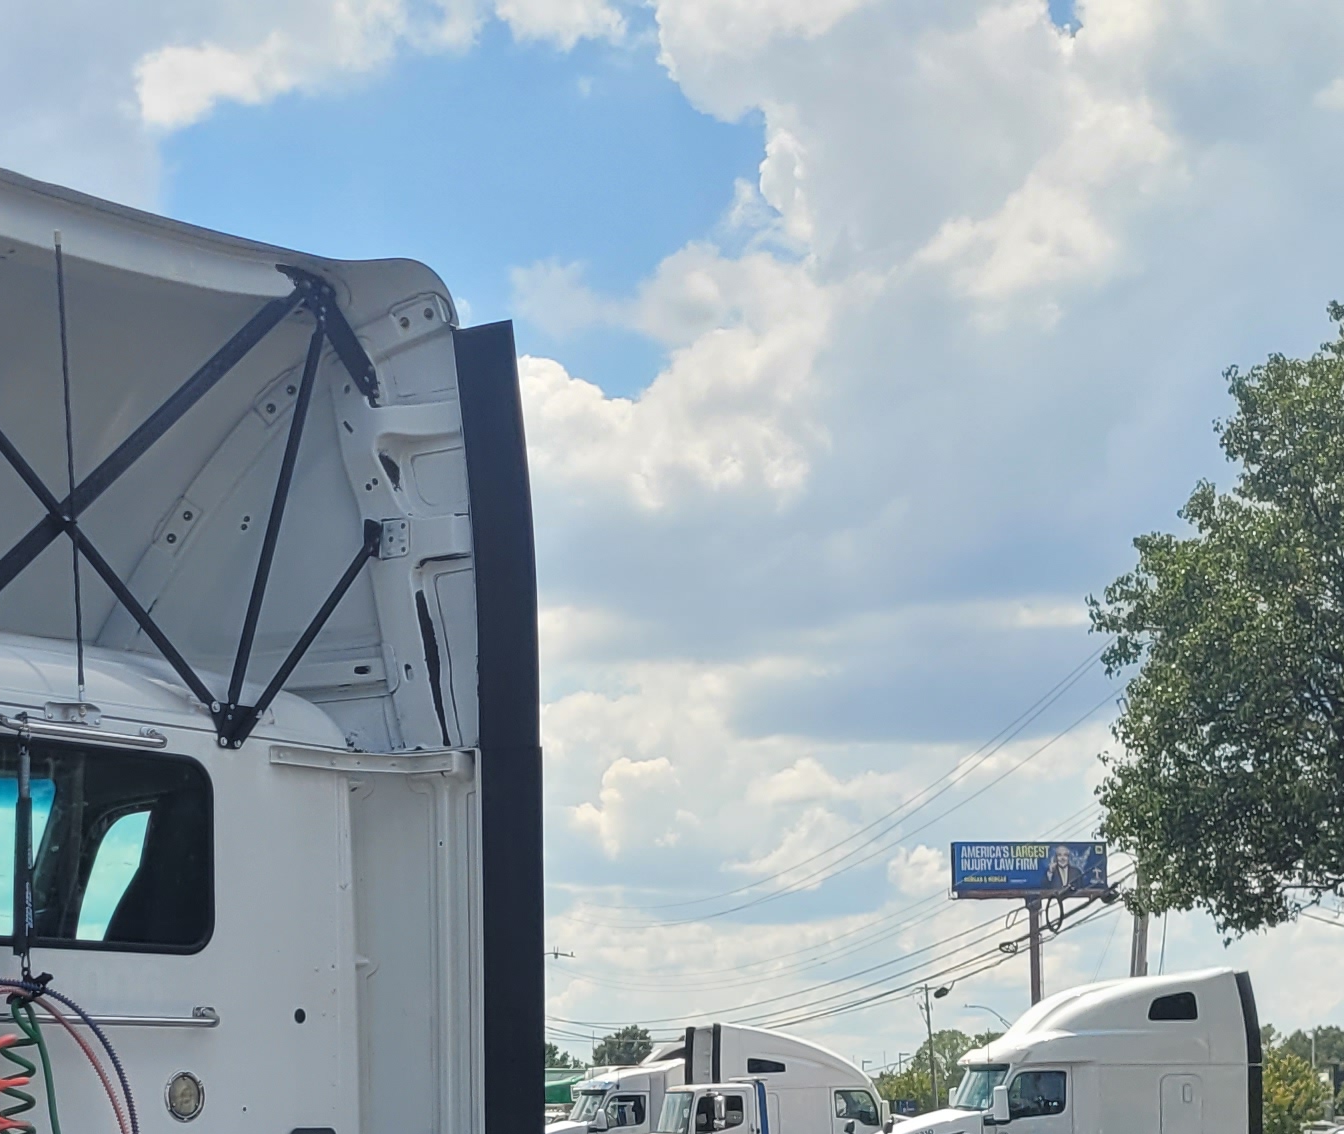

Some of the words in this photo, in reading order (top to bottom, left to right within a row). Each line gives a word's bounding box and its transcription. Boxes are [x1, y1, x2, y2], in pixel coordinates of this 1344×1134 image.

[961, 845, 1009, 858] AMERICA'S
[1010, 845, 1050, 858] LARGEST
[961, 858, 993, 871] INJURY
[994, 858, 1015, 871] LAW
[1016, 858, 1038, 871] FIRM
